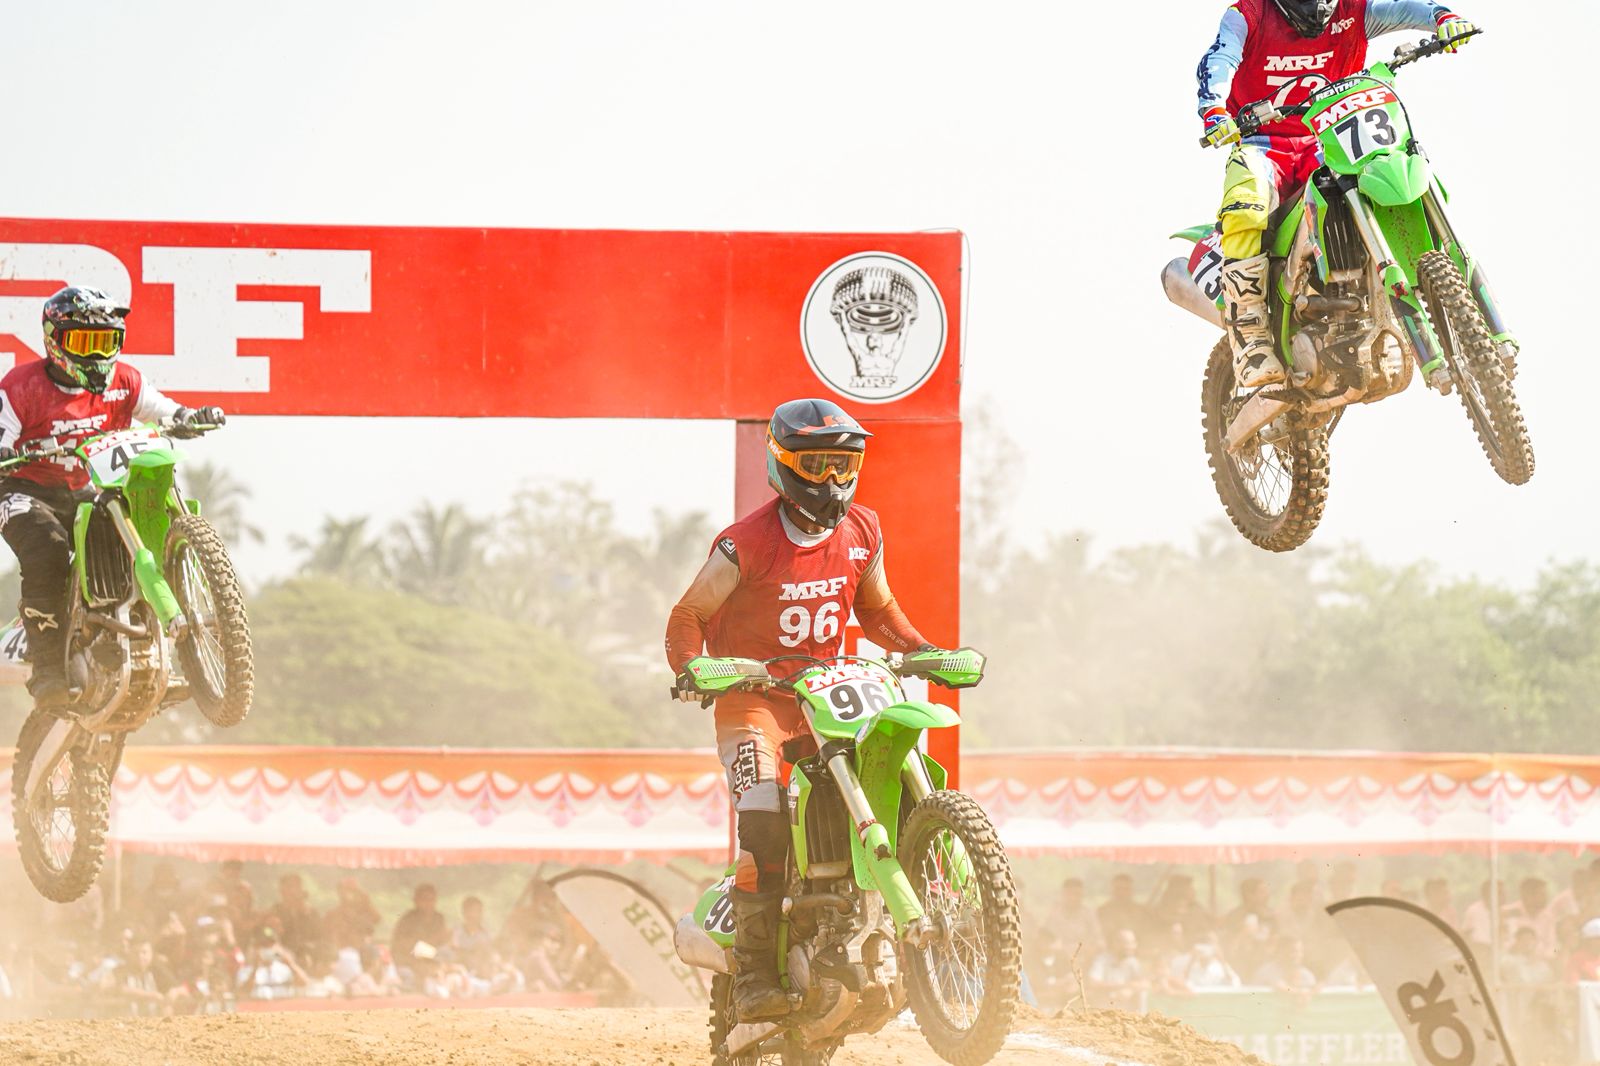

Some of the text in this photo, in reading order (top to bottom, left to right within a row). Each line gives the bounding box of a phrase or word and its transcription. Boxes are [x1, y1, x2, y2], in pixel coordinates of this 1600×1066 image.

[1330, 17, 1355, 35] MRF
[1263, 51, 1334, 72] MRF
[1314, 84, 1396, 134] MRF
[1334, 108, 1397, 160] 73
[850, 376, 898, 388] MRF
[102, 388, 129, 402] MRF
[50, 414, 107, 436] MRF
[779, 576, 847, 601] MRF
[778, 601, 841, 649] 96
[829, 682, 890, 721] 96
[704, 893, 736, 933] 96
